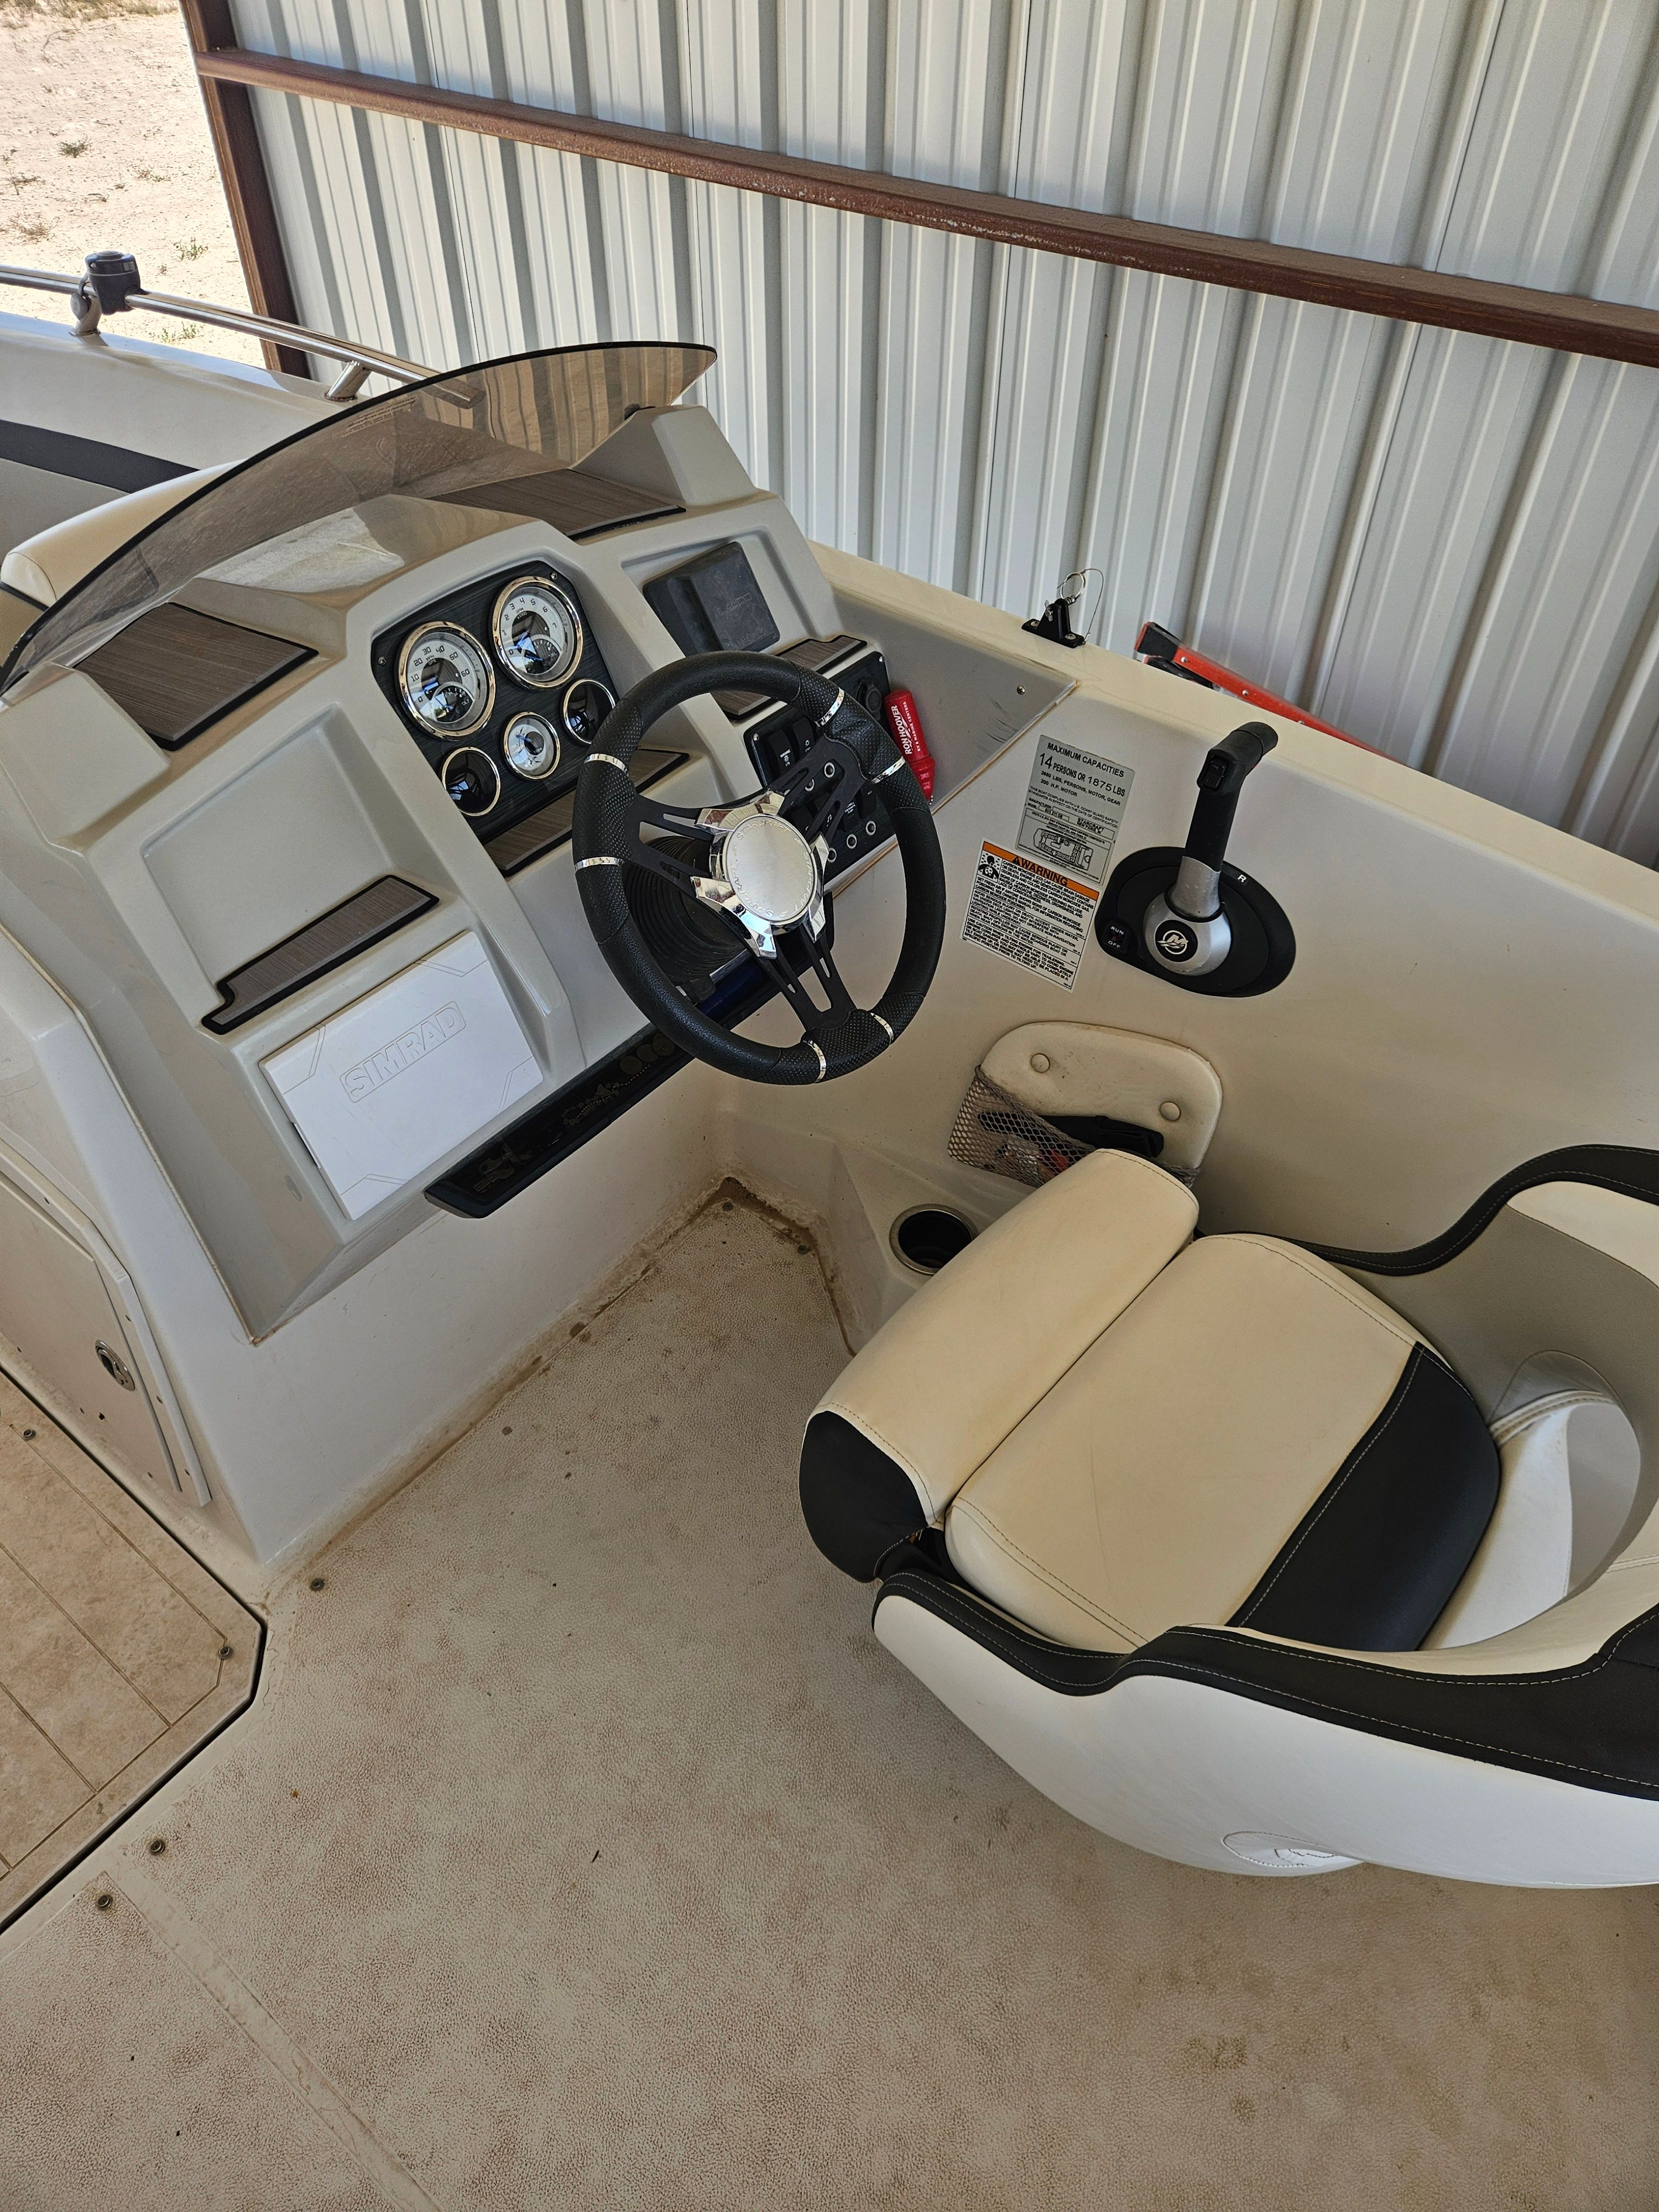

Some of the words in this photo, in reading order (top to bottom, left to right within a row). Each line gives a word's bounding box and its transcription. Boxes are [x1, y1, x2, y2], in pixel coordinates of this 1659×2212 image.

[422, 646, 431, 655] 30
[436, 645, 445, 654] 40
[449, 651, 458, 660] 50
[414, 658, 423, 666] 20
[411, 674, 419, 682] 10
[461, 669, 470, 677] 60
[891, 705, 907, 737] HOOVER
[903, 701, 912, 723] CENTERS
[901, 738, 912, 754] RON
[1047, 742, 1081, 761] MAXIMUM
[1082, 755, 1124, 778] CAPACITIES
[1038, 751, 1053, 769] 14
[1052, 762, 1077, 779] PERSONS
[1077, 771, 1086, 782] OR
[1087, 775, 1113, 792] 1875
[1112, 785, 1125, 797] LBS
[1060, 786, 1077, 797] MOTOR
[1063, 779, 1087, 793] PERSONS,
[1088, 789, 1107, 801] MOTOR,
[1107, 796, 1121, 806] GEAR
[1077, 817, 1104, 832] STARCRAFT
[1020, 858, 1068, 887] WARNING
[1237, 874, 1247, 883] R
[972, 900, 988, 910] LIGHTING
[972, 896, 994, 909] NAVIGATION
[1026, 922, 1044, 932] OPERATE
[979, 896, 992, 904] UNDER
[1003, 907, 1020, 917] LIGHTING
[1028, 919, 1049, 931] INTERFERE
[985, 895, 1001, 905] SERIOUS
[1002, 902, 1015, 911] INJURY
[1051, 925, 1064, 934] UNDER
[971, 905, 988, 916] ROTATING
[988, 913, 1010, 926] PROPELLER
[1018, 927, 1031, 936] CAUSE
[1031, 933, 1047, 943] SERIOUS
[1047, 941, 1061, 950] INJURY
[975, 921, 992, 931] CAUTION
[1004, 935, 1018, 944] TILTING
[1018, 941, 1032, 951] ENGINE
[990, 922, 1008, 932] PERSONS
[1001, 923, 1014, 932] ENGINE
[1015, 930, 1030, 939] BEFORE
[1030, 937, 1050, 948] BOARDING
[1110, 926, 1124, 935] RUN
[964, 931, 980, 942] SPECIFIC
[981, 940, 998, 951] POSITION
[998, 948, 1010, 956] PRIOR
[1016, 957, 1030, 966] TILTING
[967, 921, 980, 930] ENGINE
[980, 927, 1000, 940] COWLINGS
[1009, 941, 1030, 954] CONTROLS
[1046, 959, 1058, 968] AVOID
[1058, 965, 1073, 975] ENGINE
[1108, 940, 1121, 949] OFF
[1046, 963, 1071, 978] COMPLETELY
[345, 1008, 461, 1097] SIMRAD
